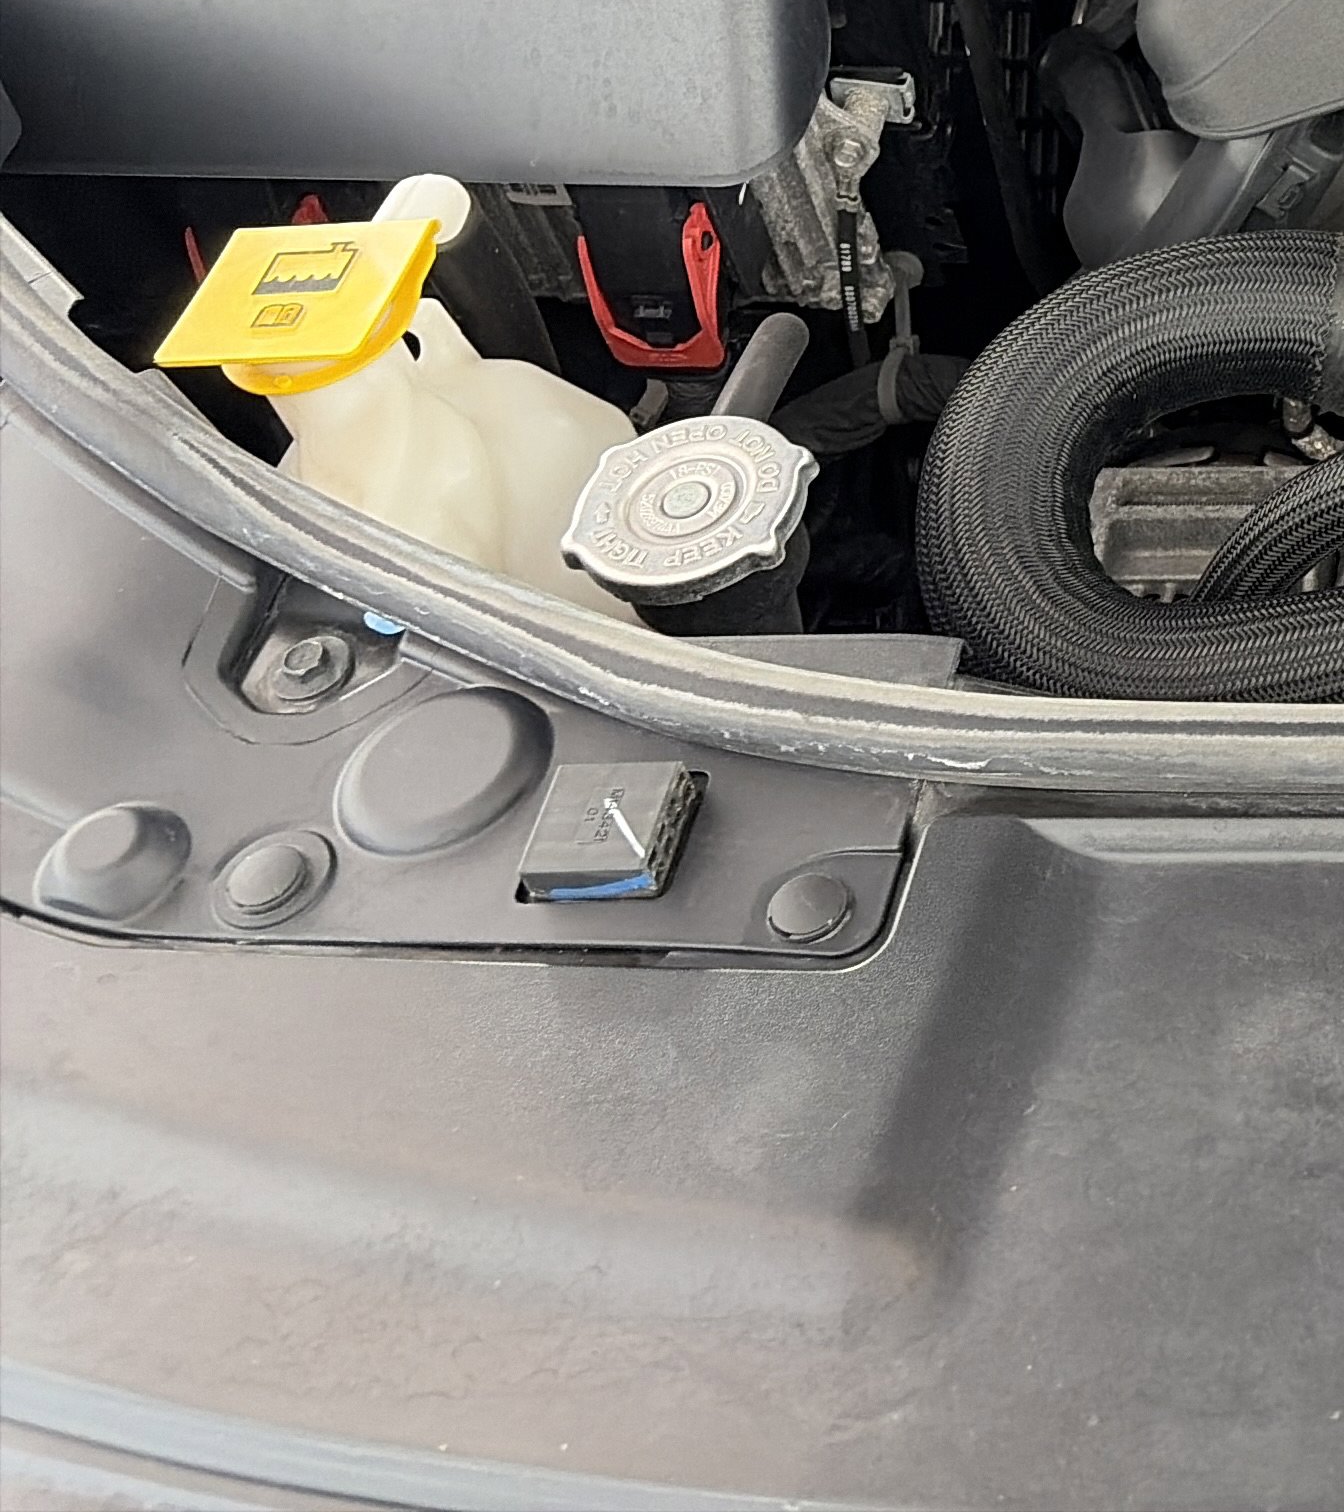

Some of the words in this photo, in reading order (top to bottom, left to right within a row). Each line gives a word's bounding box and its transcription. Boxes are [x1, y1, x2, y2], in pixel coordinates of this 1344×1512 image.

[651, 423, 727, 453] OPEN
[597, 449, 647, 494] HOT
[663, 526, 744, 568] KEEP
